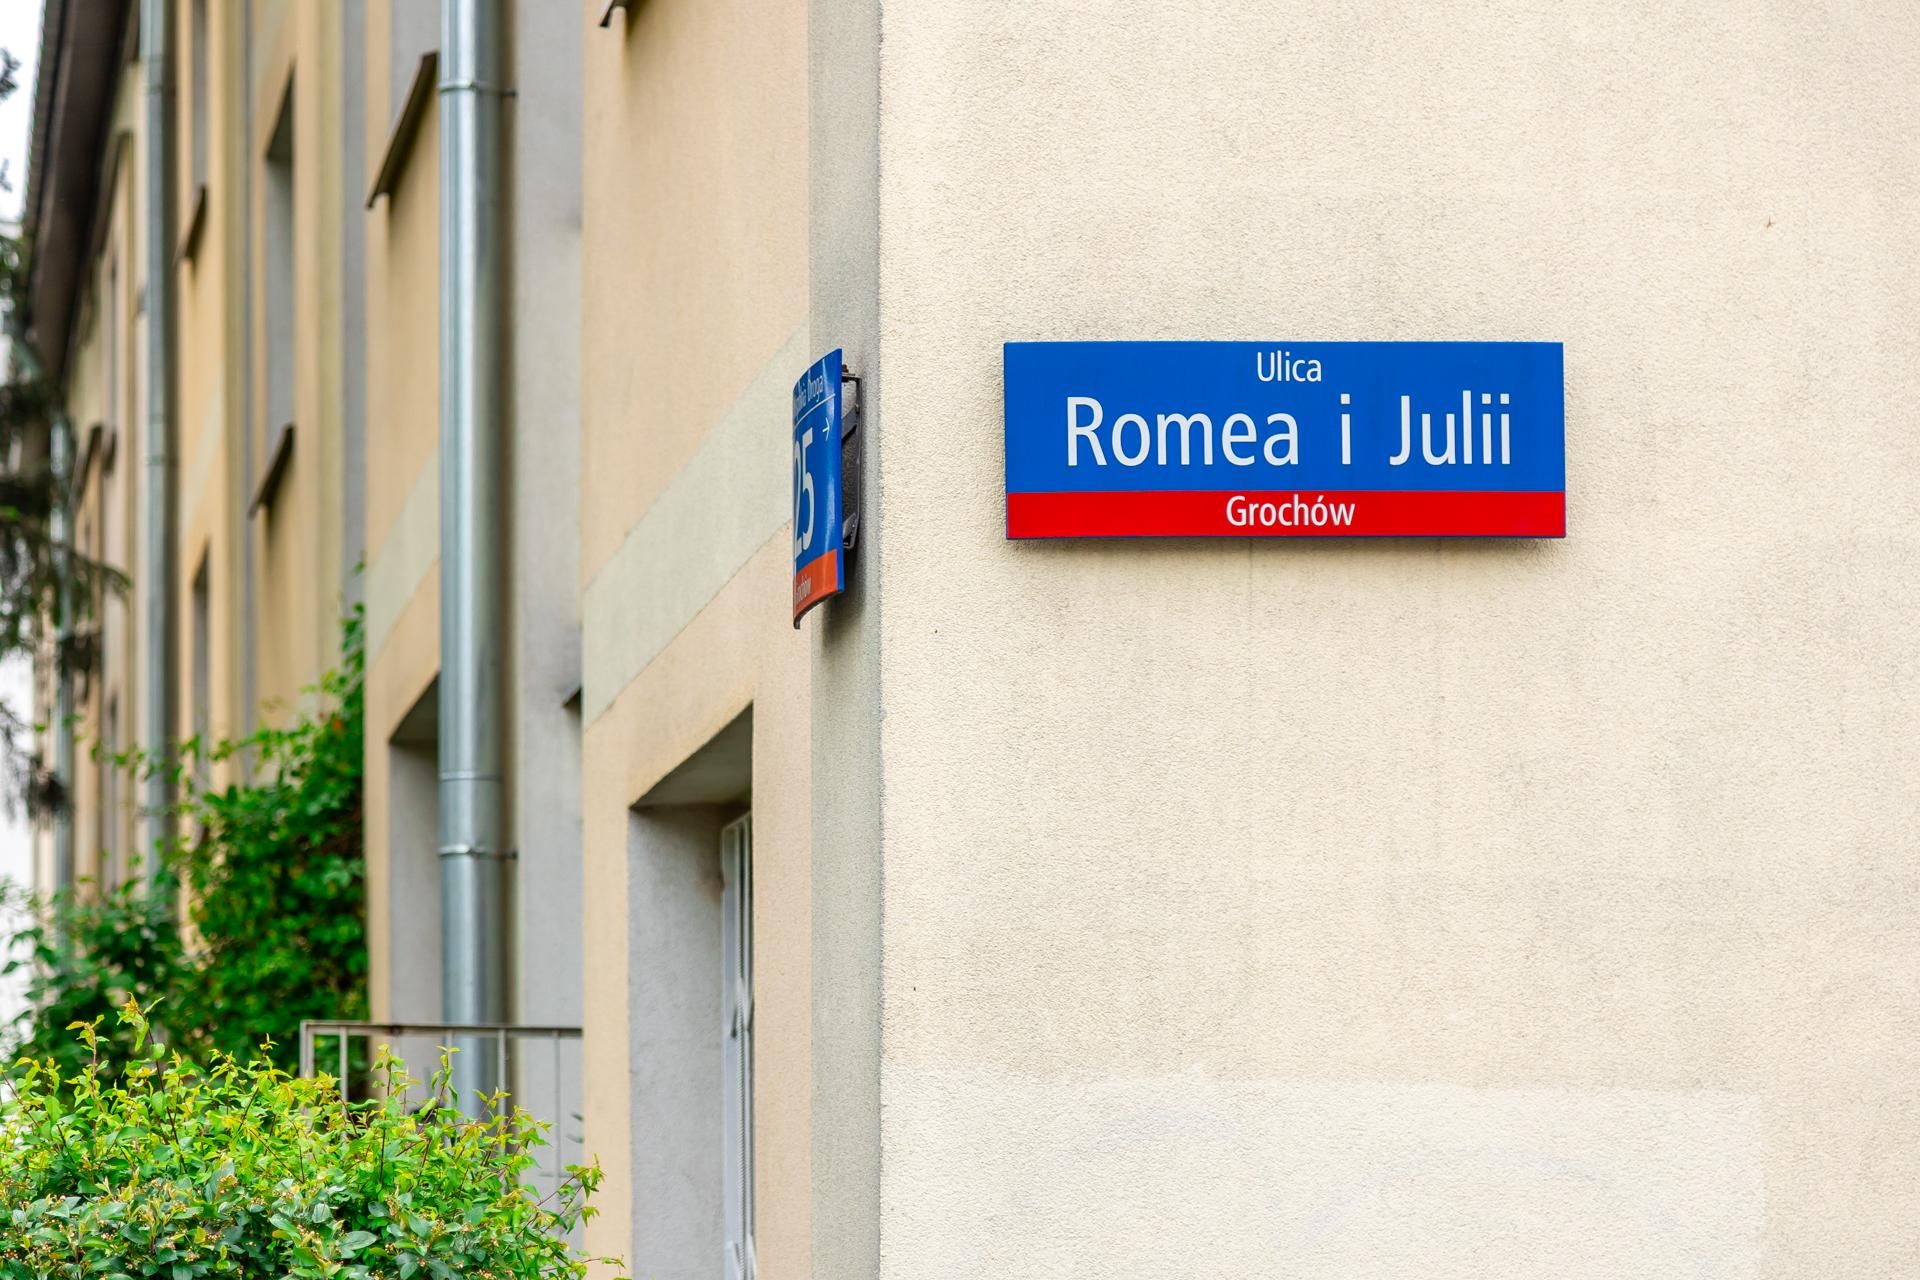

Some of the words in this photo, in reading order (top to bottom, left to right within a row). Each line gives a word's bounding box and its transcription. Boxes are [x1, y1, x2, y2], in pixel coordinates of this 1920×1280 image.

[1257, 350, 1322, 383] Ulica
[1066, 396, 1299, 467] Romea
[1340, 393, 1352, 465] i
[1389, 390, 1511, 466] Julii
[793, 427, 815, 559] 25
[1226, 494, 1356, 527] Grochów
